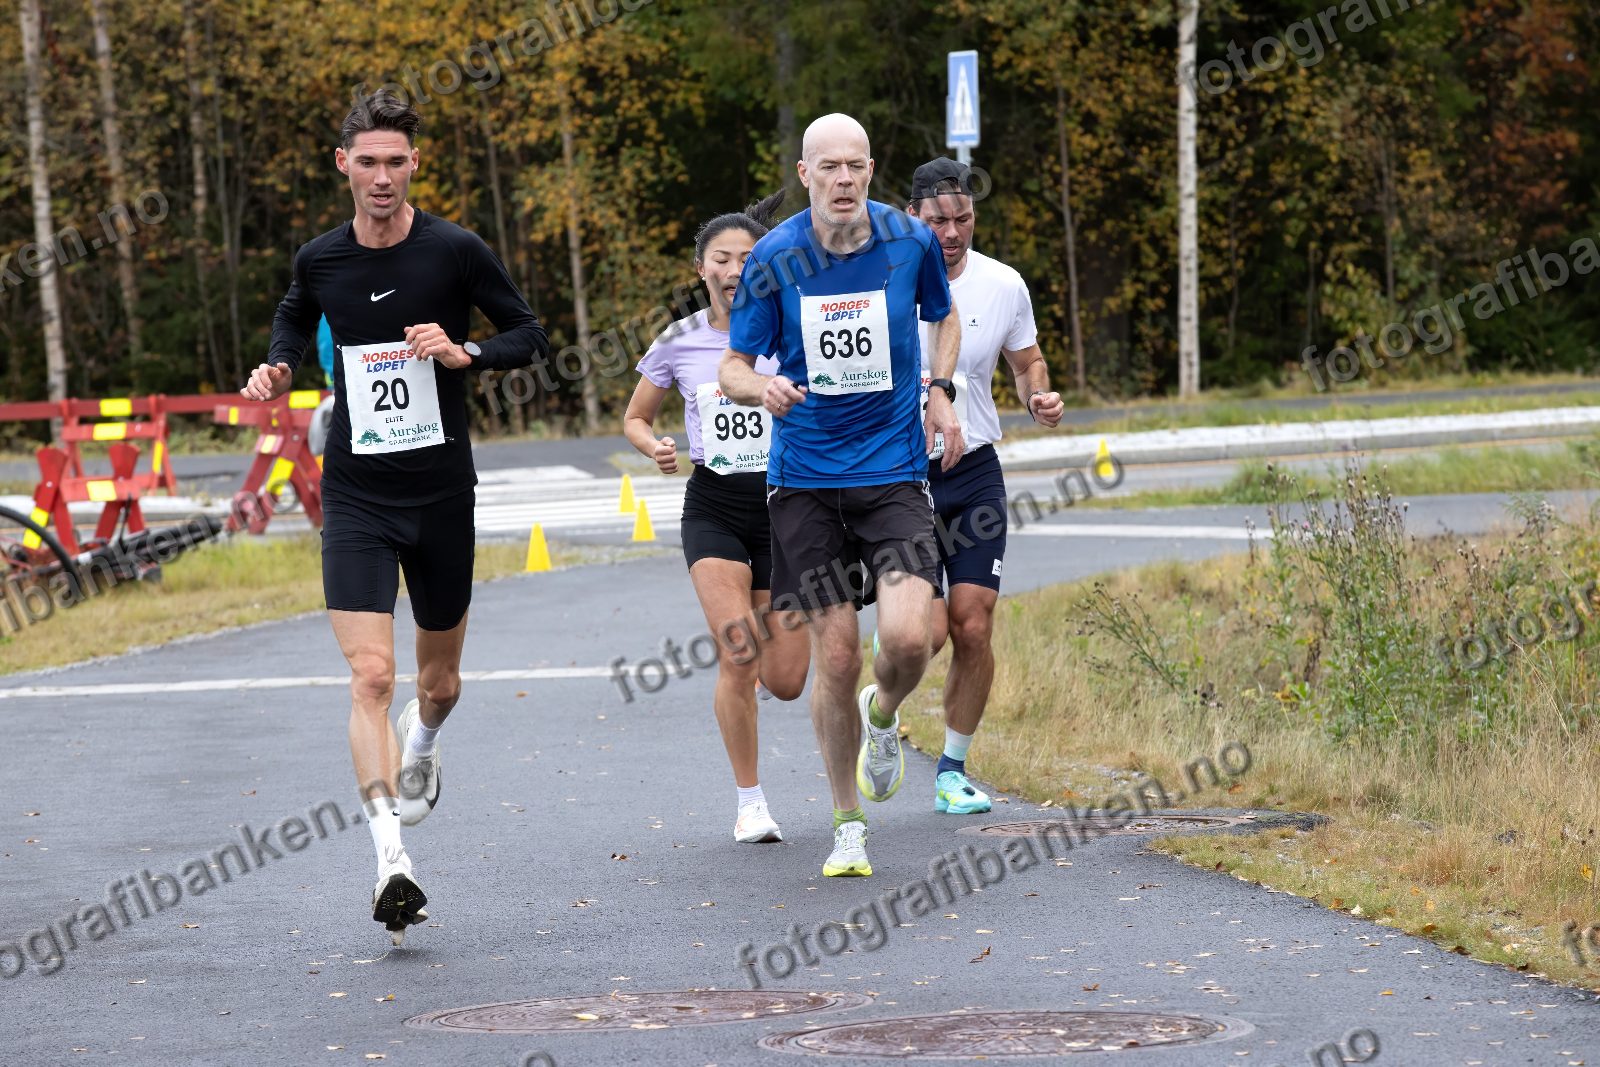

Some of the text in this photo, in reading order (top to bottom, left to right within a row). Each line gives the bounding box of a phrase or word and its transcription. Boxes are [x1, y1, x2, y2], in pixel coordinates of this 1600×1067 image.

[819, 299, 871, 313] NORGES
[825, 310, 863, 322] LØPET
[819, 326, 873, 360] 636
[359, 349, 415, 363] NORGES
[366, 360, 407, 373] LØPET
[840, 369, 888, 383] Aurskog
[371, 377, 410, 412] 20
[385, 415, 404, 424] ELITE
[714, 410, 764, 441] 983
[387, 422, 440, 439] Aurskog
[388, 434, 432, 446] SPAREBANK
